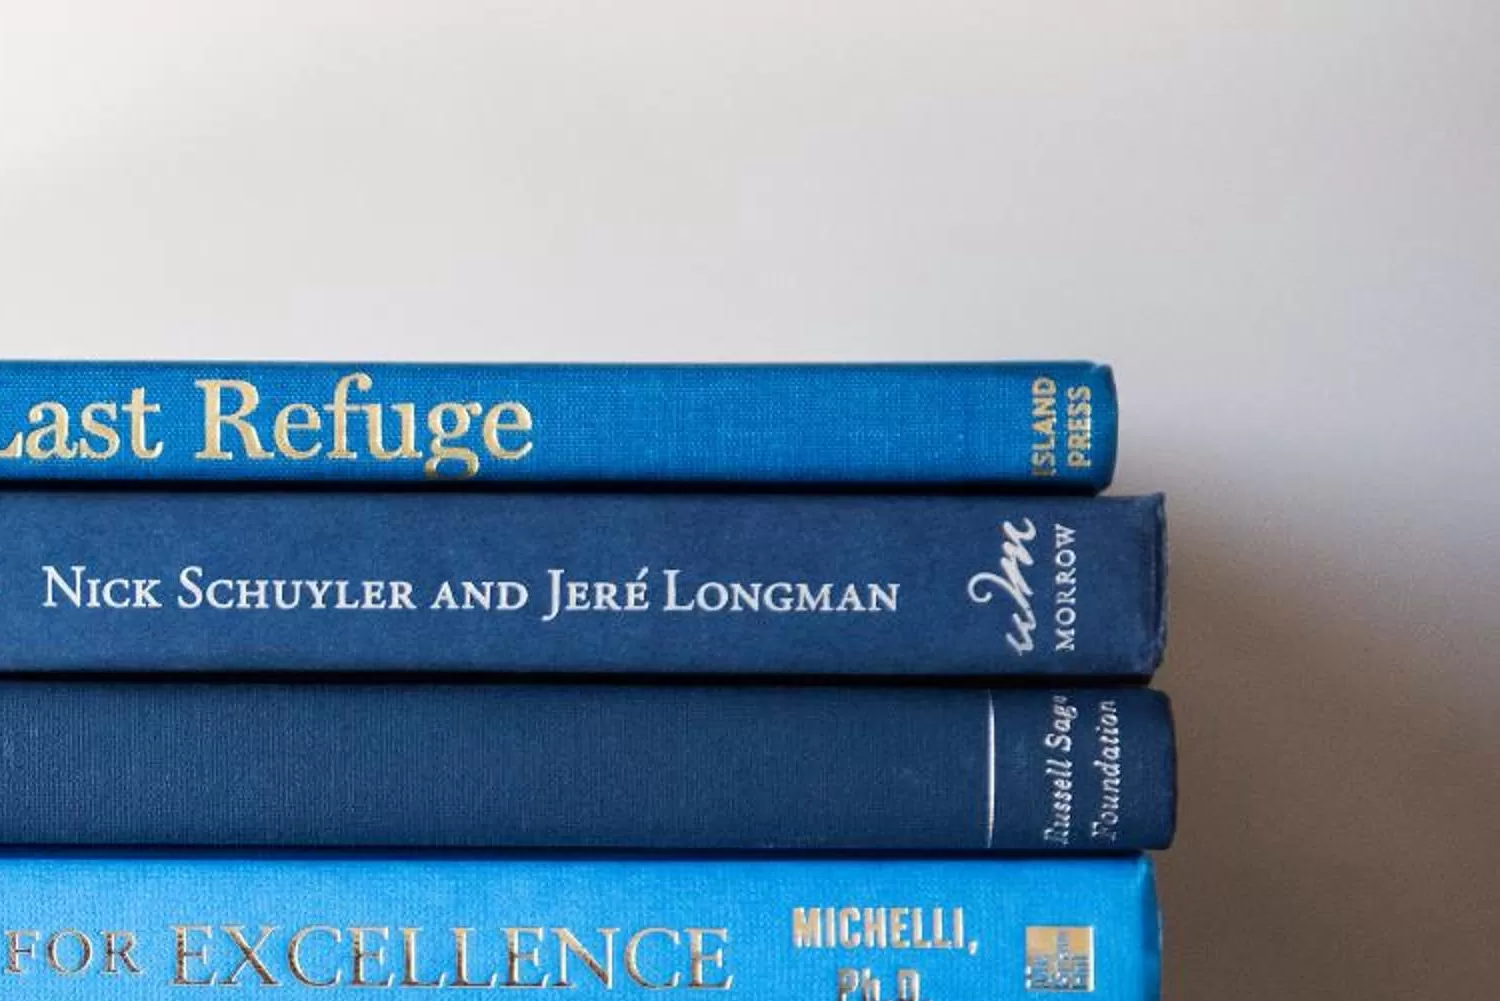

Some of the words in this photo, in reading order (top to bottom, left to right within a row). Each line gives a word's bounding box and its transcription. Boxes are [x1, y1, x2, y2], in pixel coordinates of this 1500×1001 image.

[195, 372, 533, 479] Refuge
[1031, 376, 1057, 477] ISLAND
[1067, 386, 1092, 467] PRESS
[42, 566, 161, 609] NICK
[178, 566, 416, 610] SCHUYLER
[430, 579, 527, 611] AND
[663, 569, 901, 612] LONGMAN
[1055, 523, 1077, 651] MORROW
[1044, 759, 1072, 845] Russell
[1092, 700, 1120, 841] Foundation
[4, 929, 142, 975] FOR
[170, 924, 734, 990] EXCELLENCE
[792, 907, 978, 955] MICHELLI,
